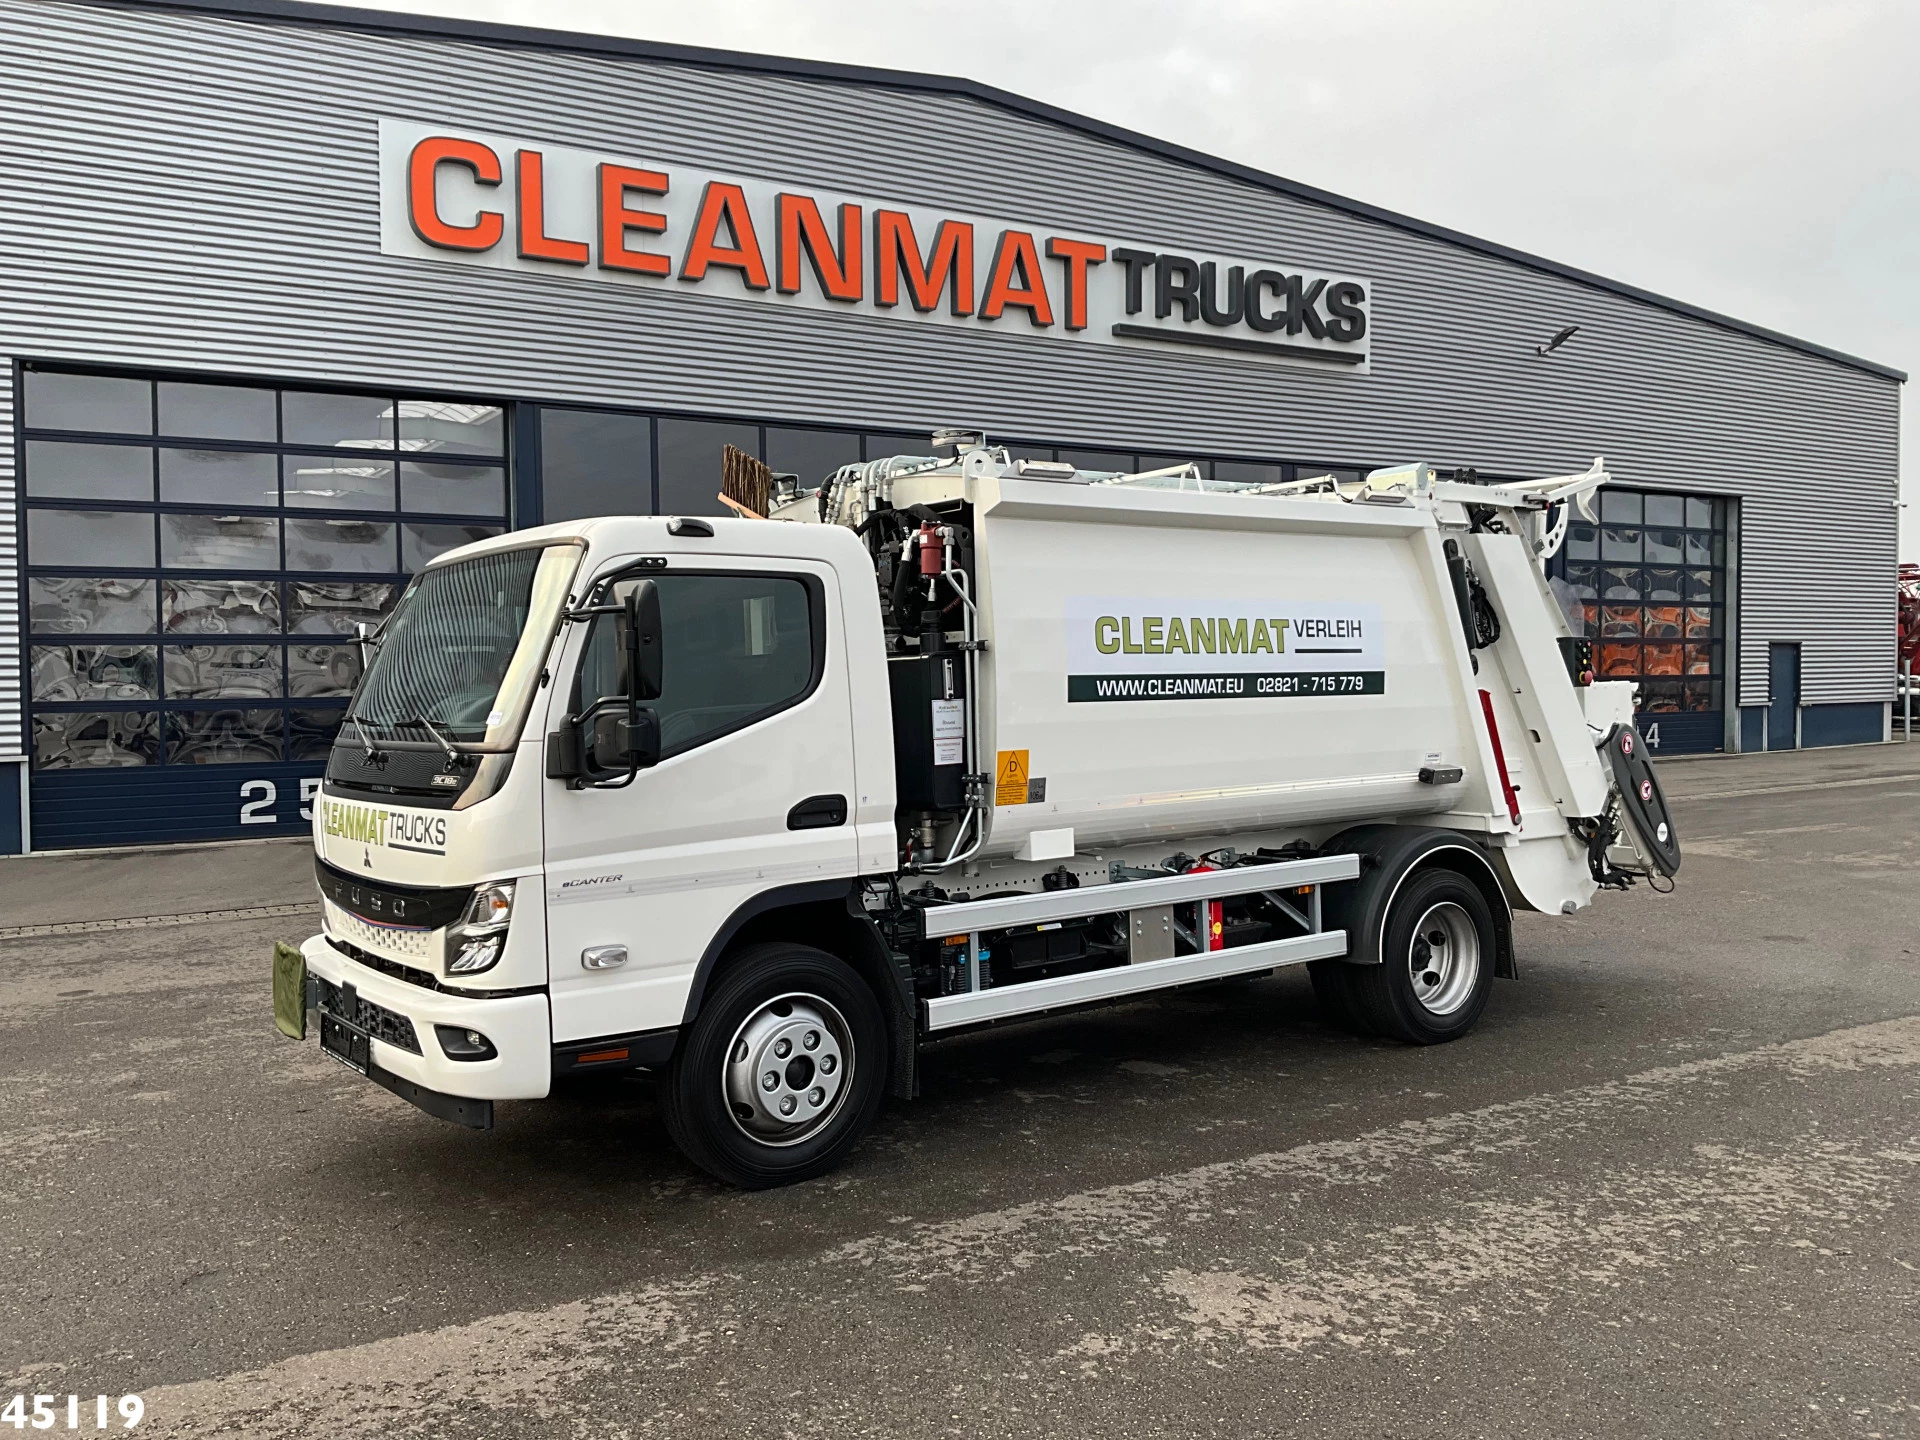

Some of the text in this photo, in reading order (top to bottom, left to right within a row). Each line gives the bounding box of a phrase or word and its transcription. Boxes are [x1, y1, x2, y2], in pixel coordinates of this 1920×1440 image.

[406, 135, 1367, 344] CLEANMAT TRUCKS
[1095, 616, 1363, 655] CLEANMAT VERLEIH
[1096, 678, 1245, 697] WWW.CLEANMAT.EU
[1257, 677, 1299, 693] 02821
[1311, 676, 1336, 692] 715
[1339, 676, 1364, 691] 779
[1010, 761, 1018, 772] D
[389, 812, 446, 846] TRUCKS
[334, 882, 406, 918] FUSO
